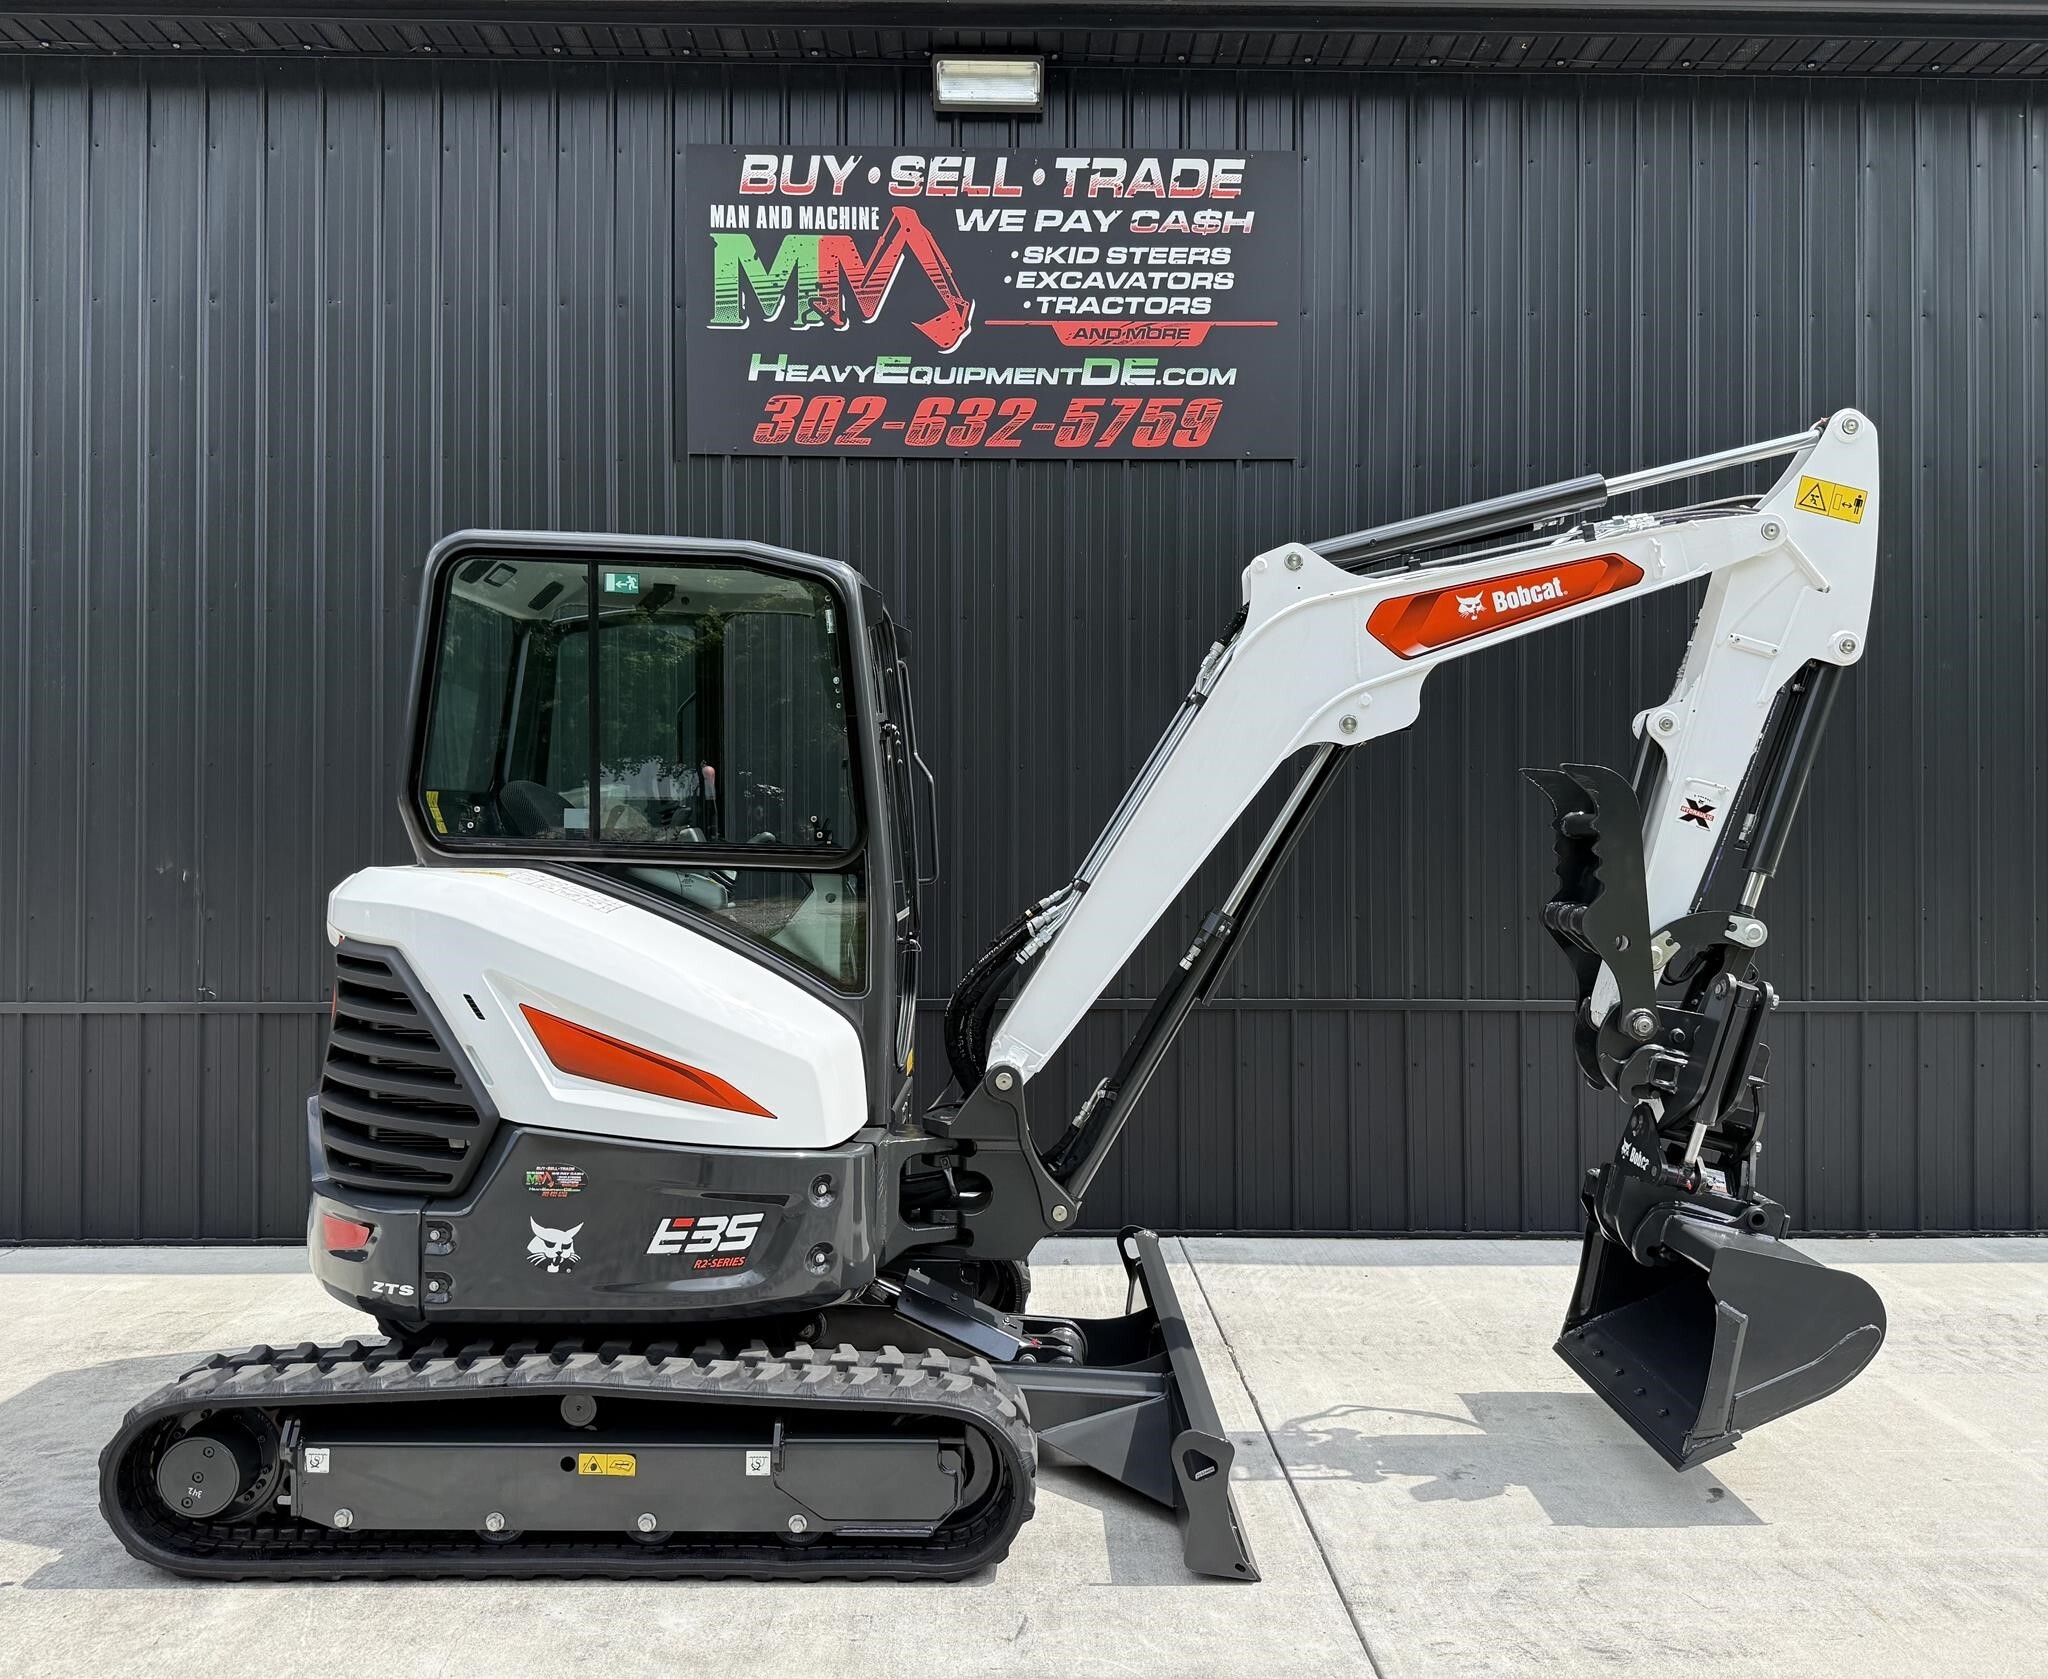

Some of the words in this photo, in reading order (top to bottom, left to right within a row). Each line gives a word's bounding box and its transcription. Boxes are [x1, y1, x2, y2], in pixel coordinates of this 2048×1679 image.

[739, 154, 863, 195] BUY
[888, 155, 1023, 197] SELL
[1055, 157, 1246, 198] TRADE
[710, 204, 749, 228] MAN
[756, 205, 792, 229] AND
[800, 206, 880, 231] MACHINE
[955, 208, 1026, 232] WE
[1034, 209, 1123, 232] PAY
[1022, 246, 1100, 264] SKID
[1106, 247, 1232, 265] STEERS
[1015, 271, 1235, 290] EXCAVATORS
[1036, 296, 1212, 315] TRACTORS
[1125, 328, 1191, 340] MORE
[752, 394, 1224, 448] 302-632-5759
[1491, 576, 1564, 613] Bobcat
[646, 1213, 765, 1255] E35
[693, 1256, 746, 1270] R2-SERIES
[371, 1281, 415, 1296] ZTS
